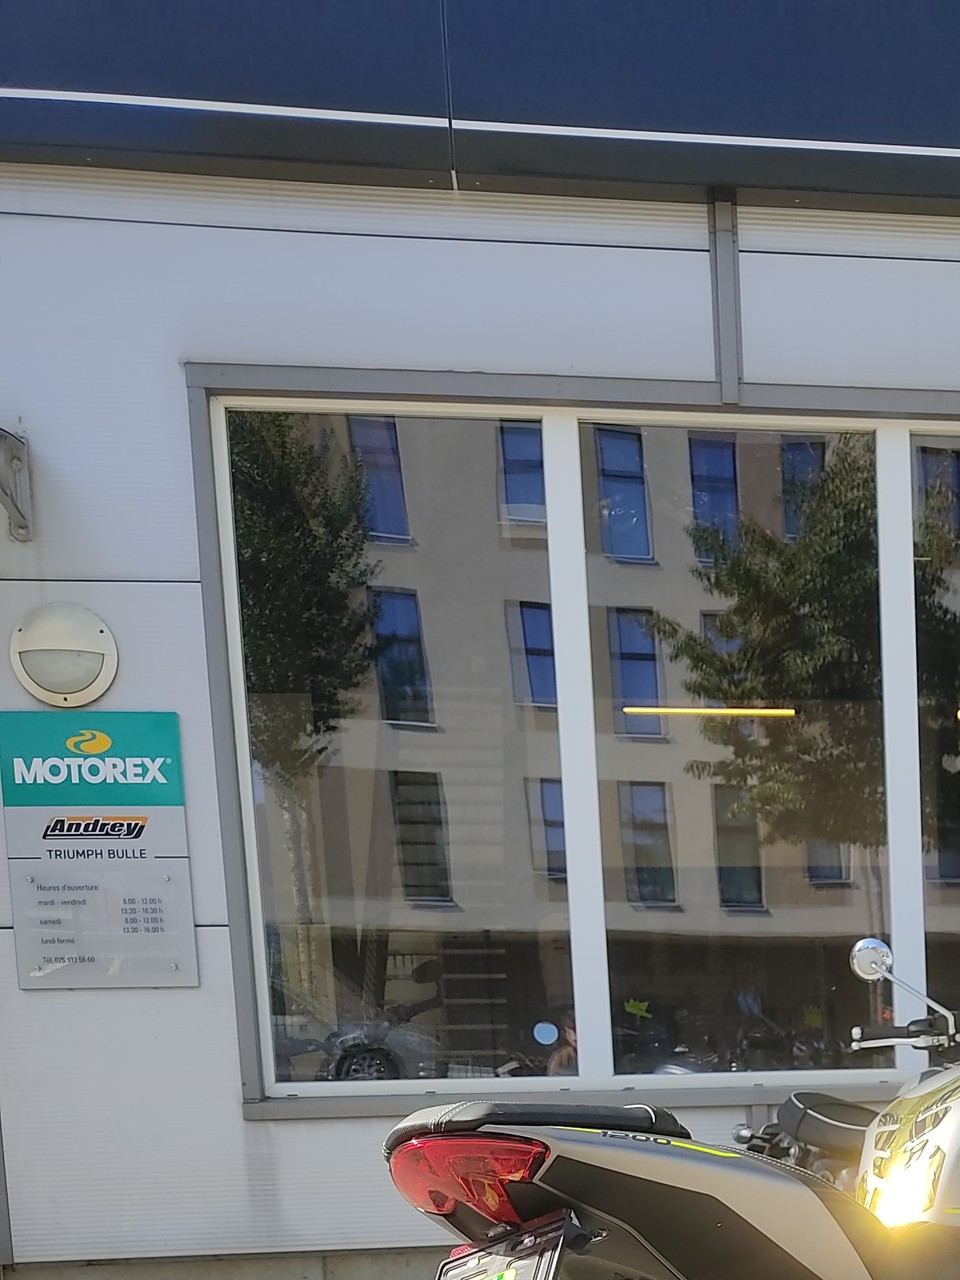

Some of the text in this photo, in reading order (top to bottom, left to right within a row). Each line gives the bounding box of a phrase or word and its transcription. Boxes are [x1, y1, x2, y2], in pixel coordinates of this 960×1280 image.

[13, 757, 168, 785] MOTOREX
[48, 817, 142, 839] Andrey
[46, 848, 148, 860] TRIUMPH BULLE
[36, 884, 99, 892] Heures d'ouverture
[600, 1130, 671, 1146] 1200
